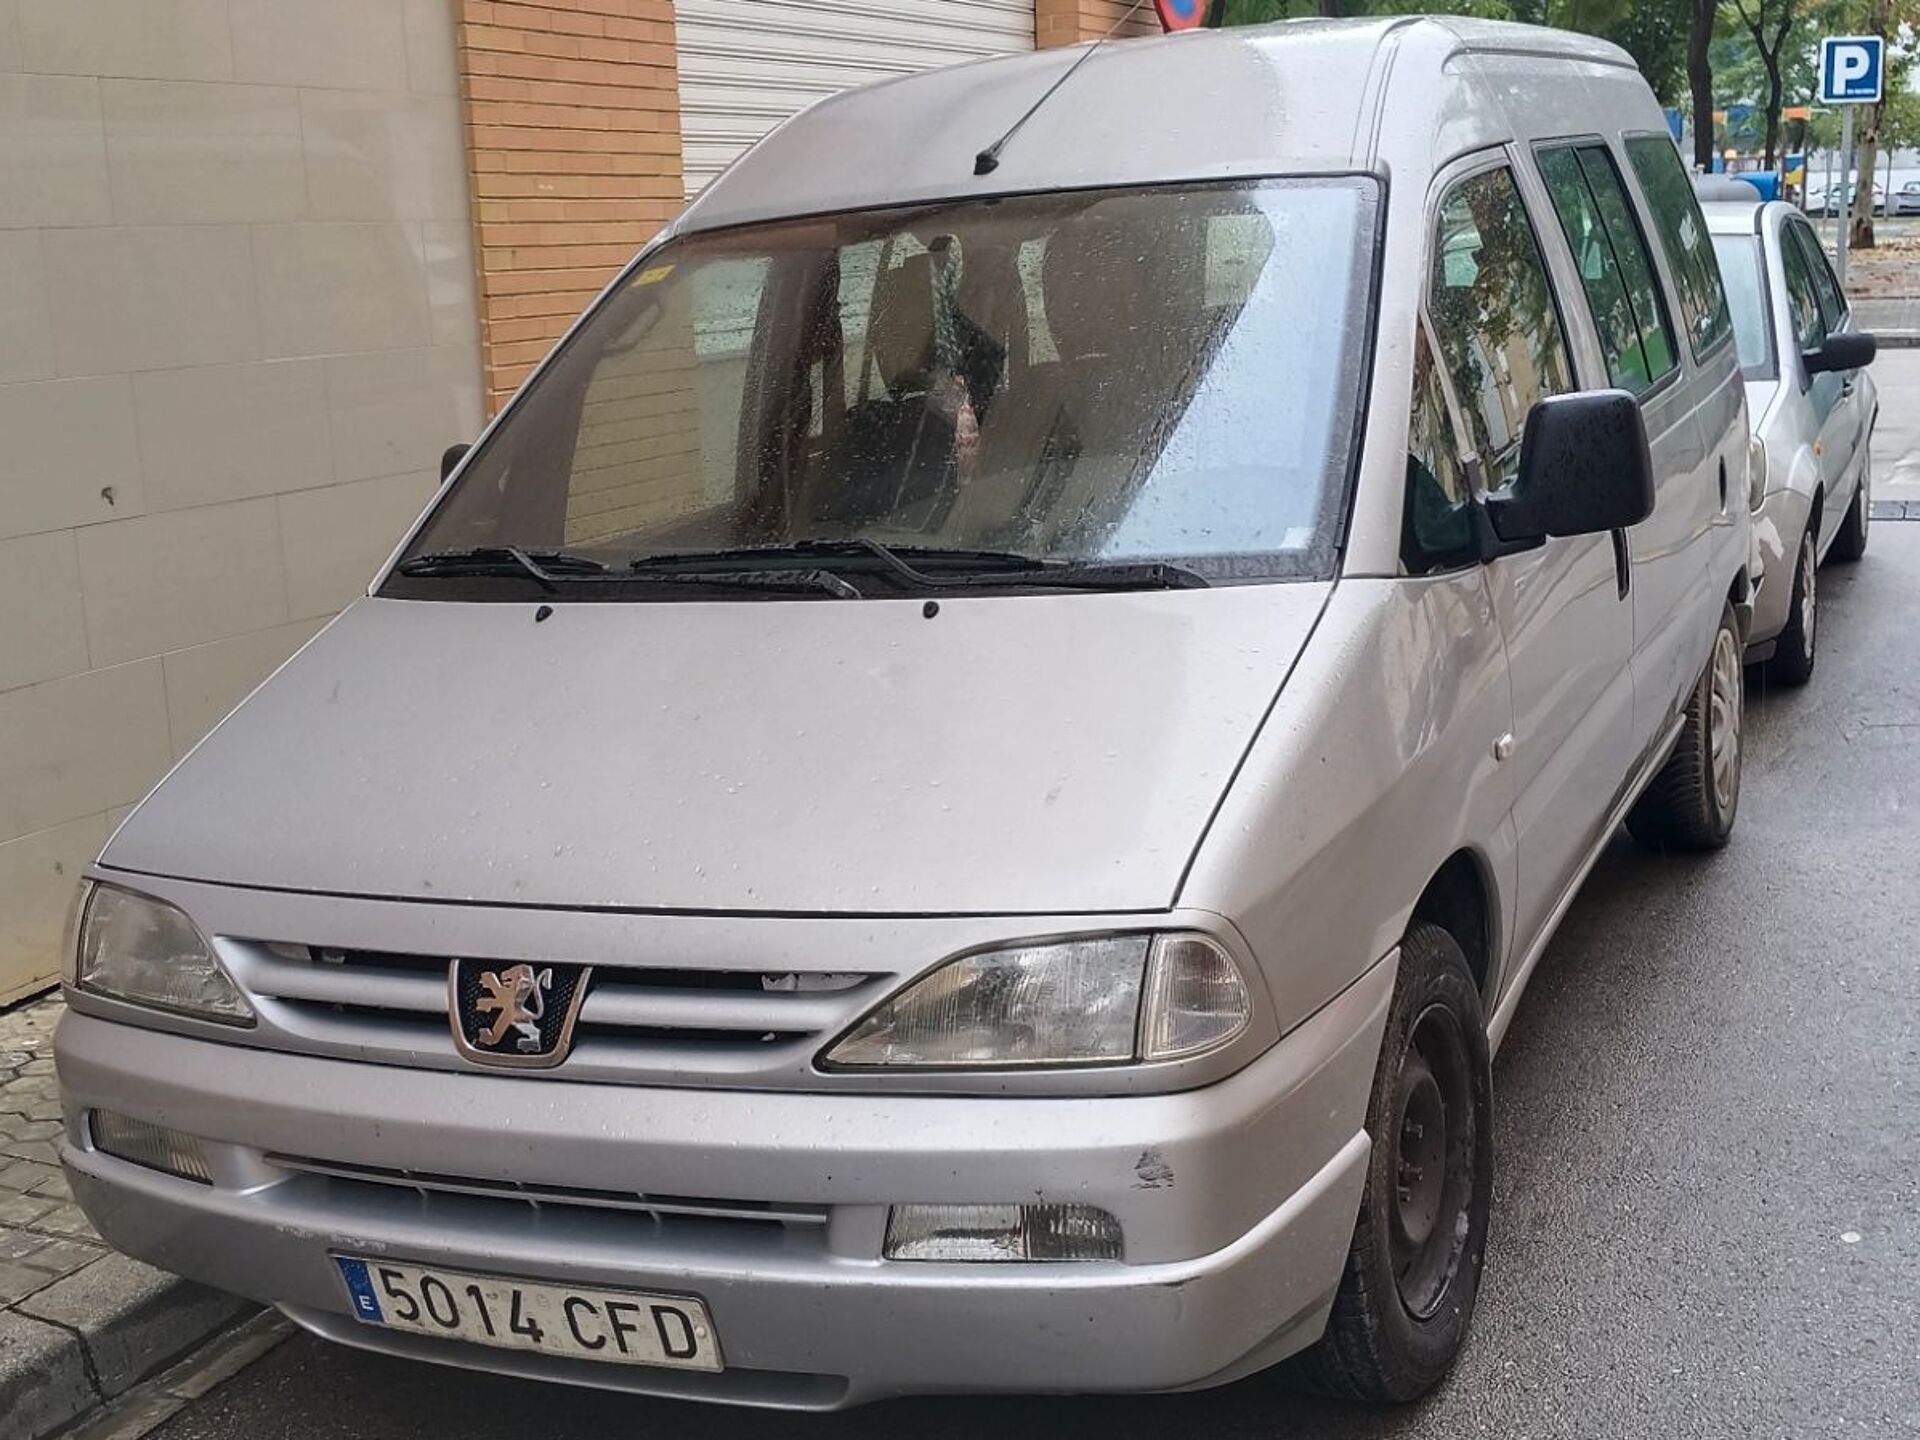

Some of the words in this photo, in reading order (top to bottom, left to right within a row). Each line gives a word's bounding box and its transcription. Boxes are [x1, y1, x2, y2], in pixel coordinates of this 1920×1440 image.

[1832, 45, 1870, 96] P
[358, 1294, 375, 1311] E
[378, 1267, 545, 1344] 5014
[563, 1296, 699, 1360] CFD
